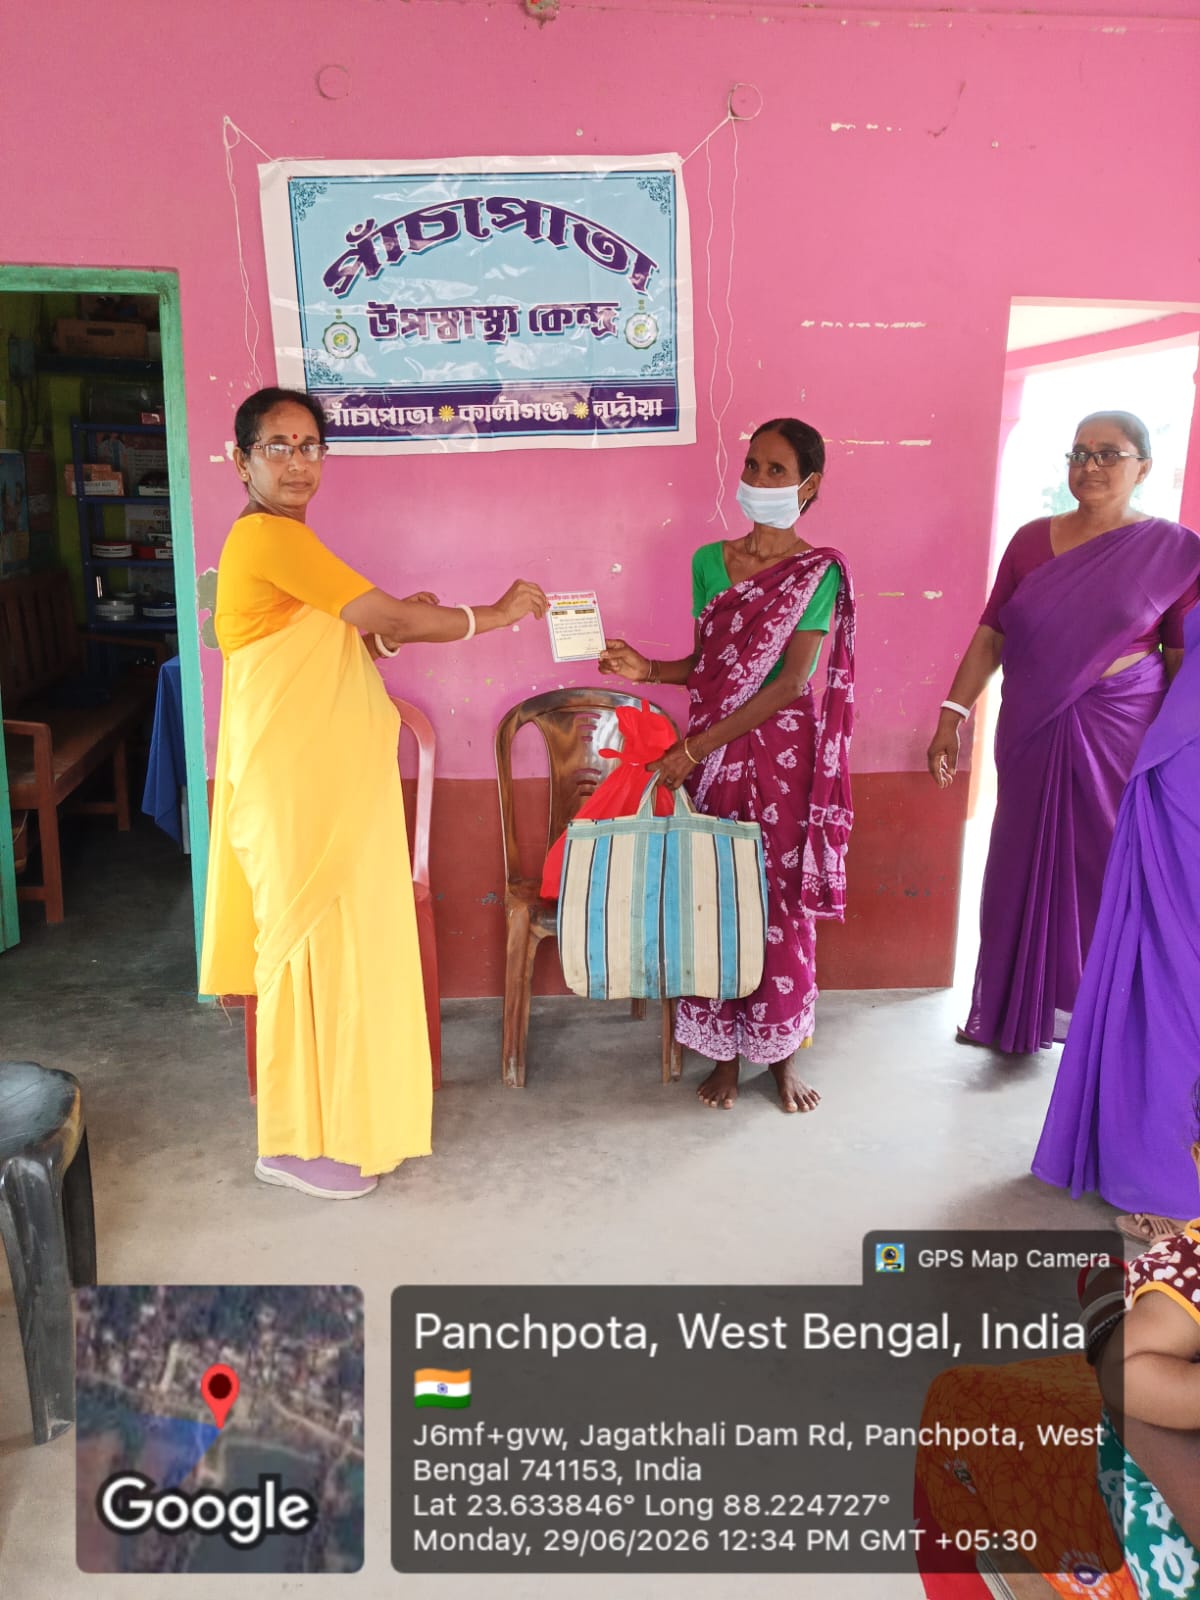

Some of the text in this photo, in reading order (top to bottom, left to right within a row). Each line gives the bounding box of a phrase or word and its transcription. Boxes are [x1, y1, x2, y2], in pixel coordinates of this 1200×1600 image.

[323, 196, 658, 295] পাঁচপোতা
[366, 302, 520, 342] উপস্বাস্থ্য
[528, 301, 620, 338] কেন্দ্র
[457, 395, 570, 423] কালীগঞ্জ
[591, 391, 665, 421] নদীয়া
